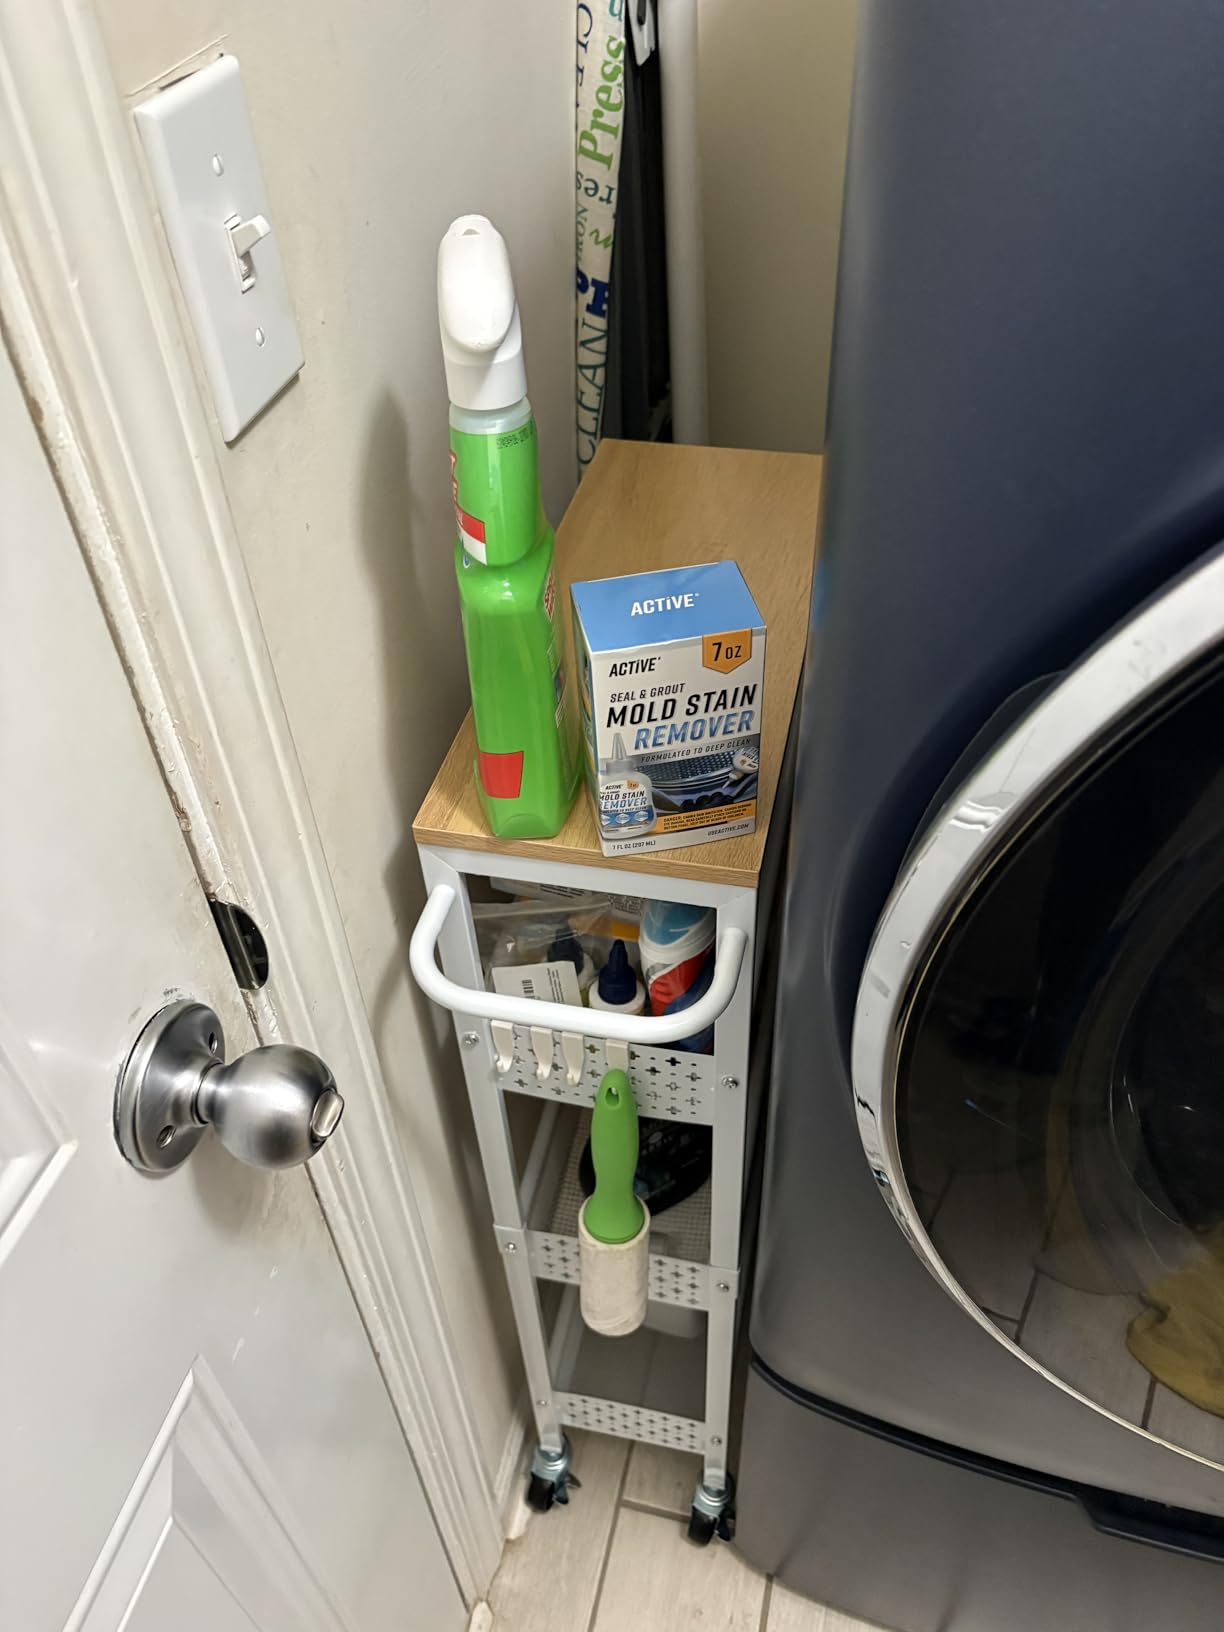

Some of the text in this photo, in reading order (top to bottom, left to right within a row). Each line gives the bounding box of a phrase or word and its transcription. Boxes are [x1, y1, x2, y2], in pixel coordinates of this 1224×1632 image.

[577, 35, 625, 171] Press
[712, 641, 742, 662] 7 OZ
[610, 683, 685, 703] SEAL & GROUT
[607, 684, 757, 728] MOLD STAIN
[635, 710, 755, 750] REMOVER
[641, 750, 691, 763] FORMULATED
[706, 743, 724, 752] DEEP
[727, 739, 751, 748] CLEAN
[600, 797, 646, 809] EMOVER
